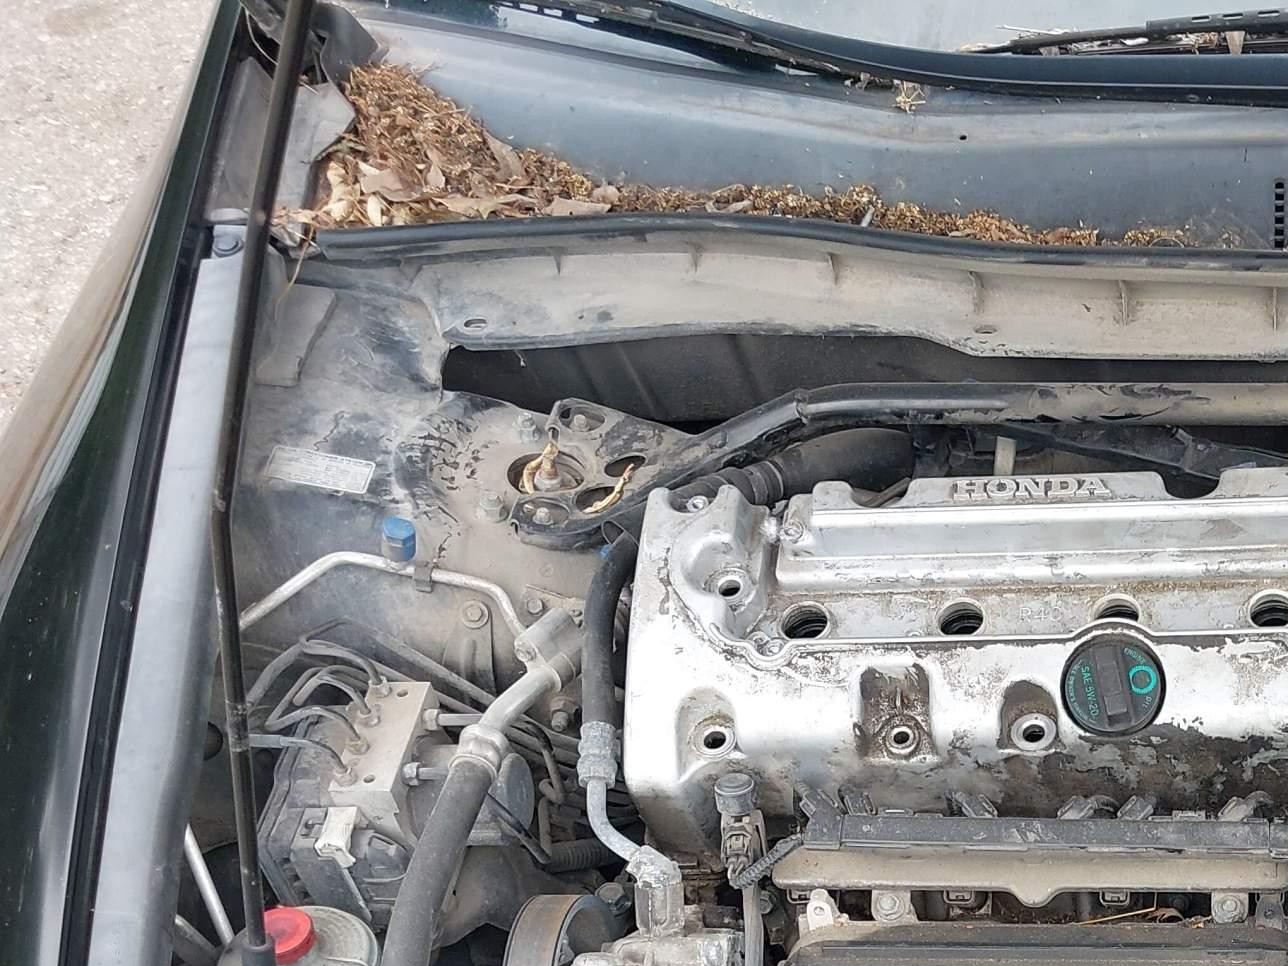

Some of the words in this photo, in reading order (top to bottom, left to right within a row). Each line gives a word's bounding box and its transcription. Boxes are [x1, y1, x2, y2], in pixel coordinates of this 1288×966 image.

[953, 477, 1111, 500] HONDA
[1123, 644, 1145, 666] ENGINE
[1081, 665, 1092, 684] SAE
[1085, 685, 1099, 716] 5W-20
[1141, 695, 1153, 708] OIL
